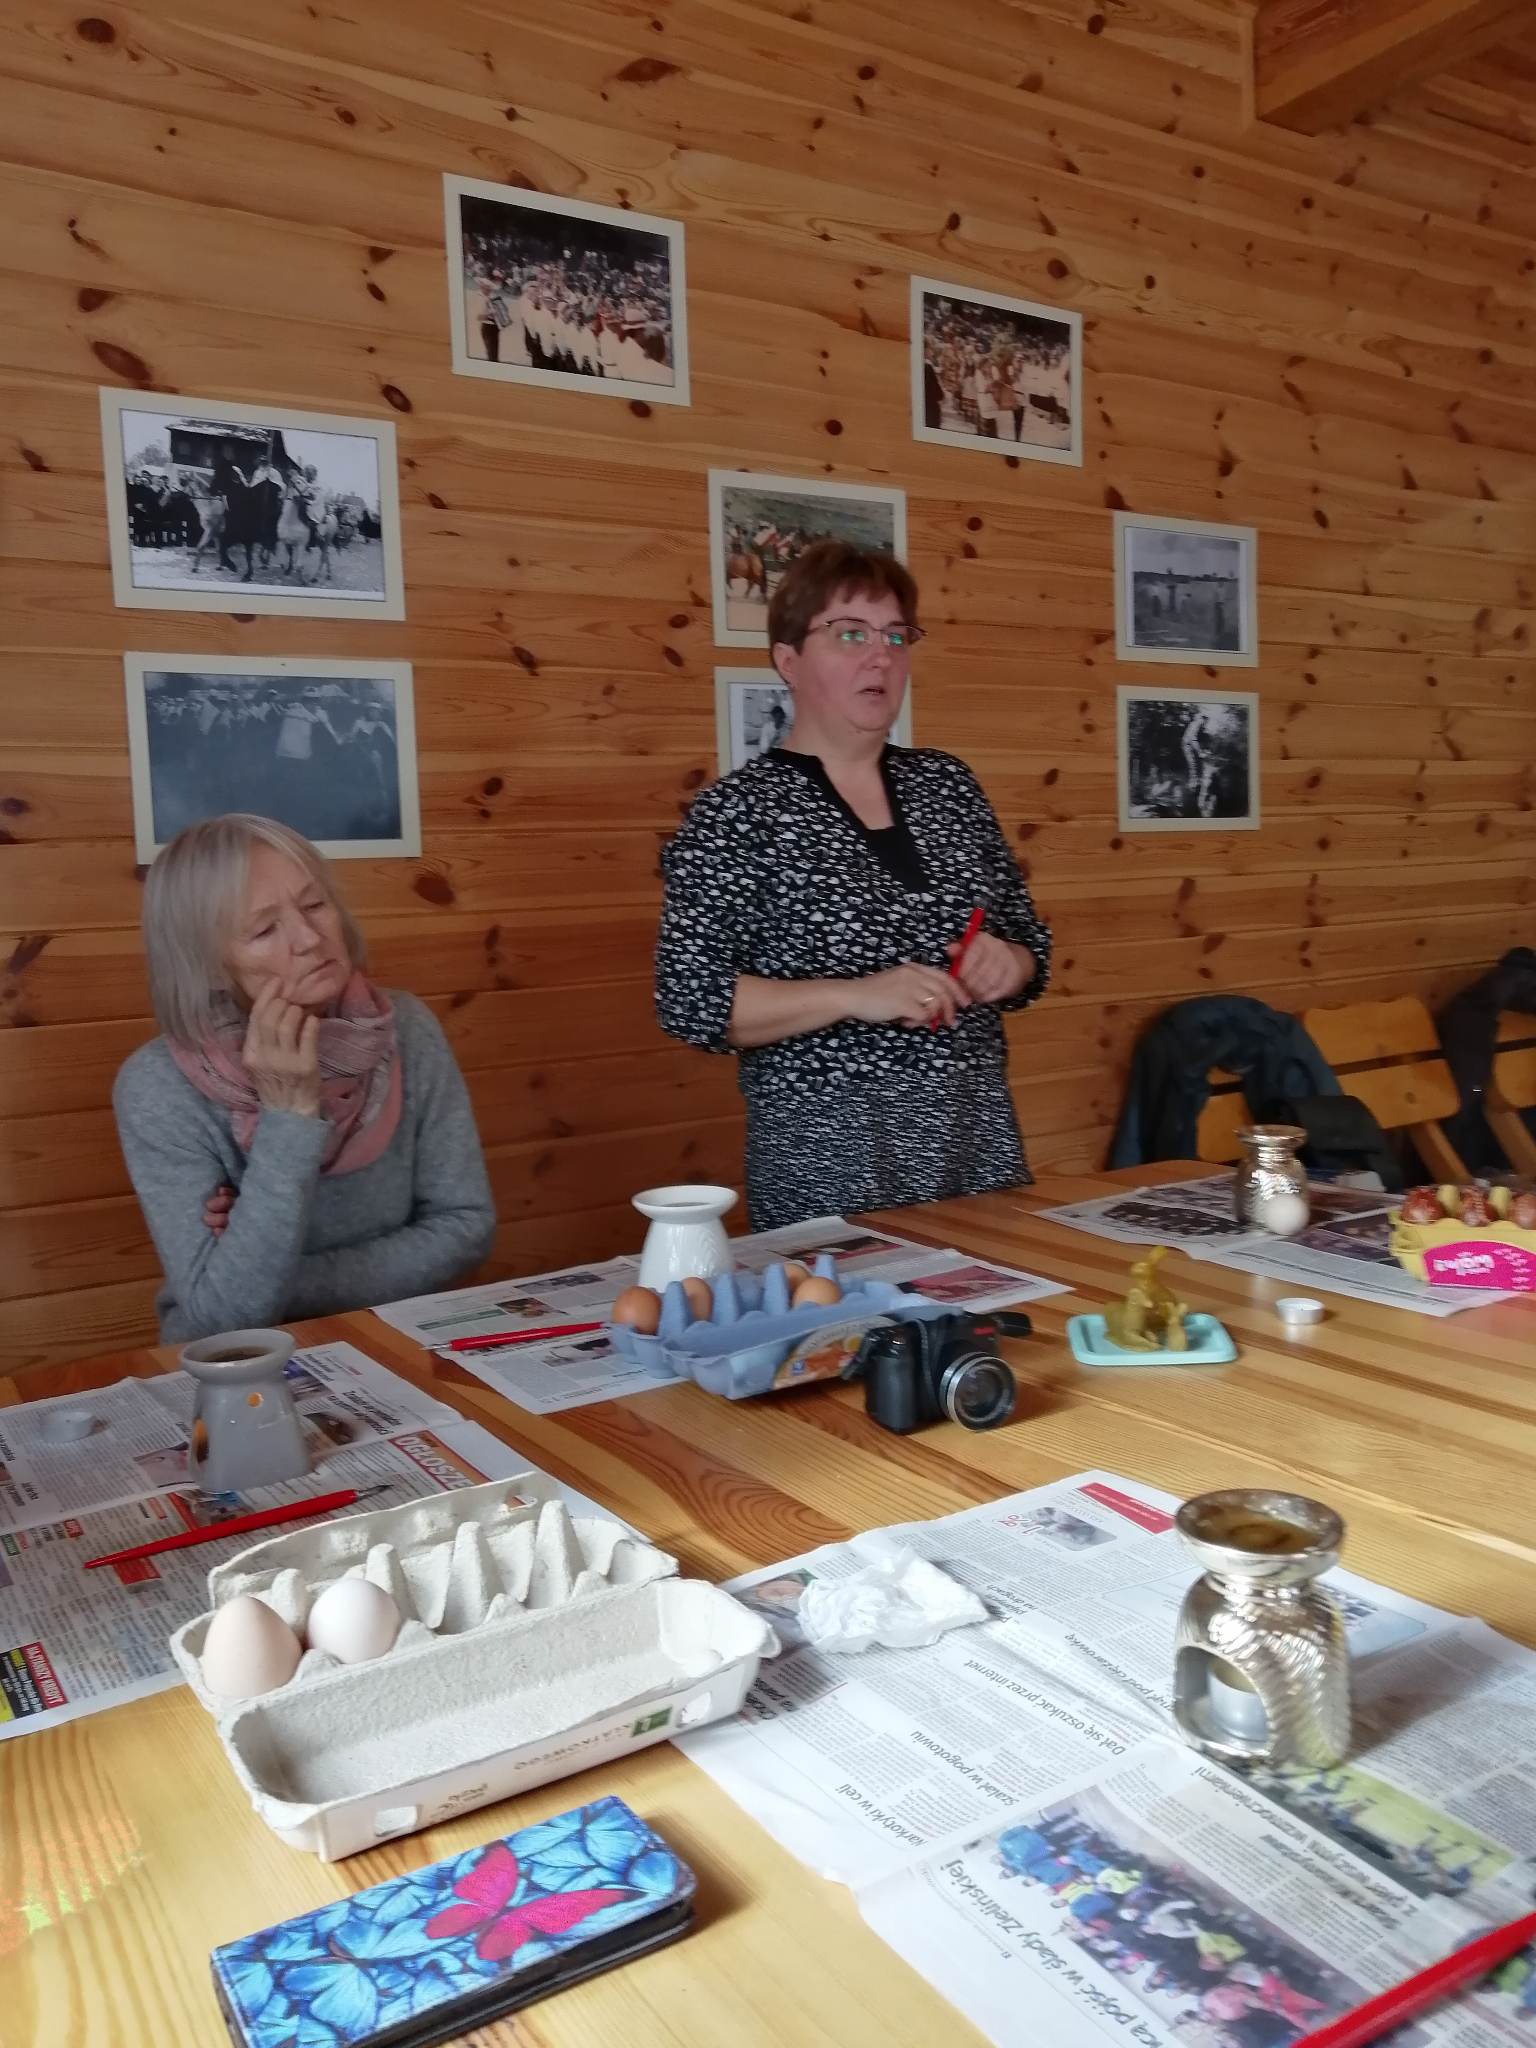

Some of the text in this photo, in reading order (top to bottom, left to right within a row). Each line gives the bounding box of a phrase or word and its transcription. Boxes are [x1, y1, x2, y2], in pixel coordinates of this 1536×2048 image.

[964, 1659, 1126, 1756] Dał się oszukać przez internet
[910, 1730, 973, 1779] pogotowiu
[835, 1783, 862, 1803] celi
[980, 1780, 1020, 1806] Szalał
[870, 1807, 928, 1847] Narkotyki
[939, 1858, 1024, 1934] Zielińskiej
[1017, 1931, 1068, 1971] ślady
[1061, 1969, 1085, 1987] w
[1074, 1983, 1138, 2026] pójść
